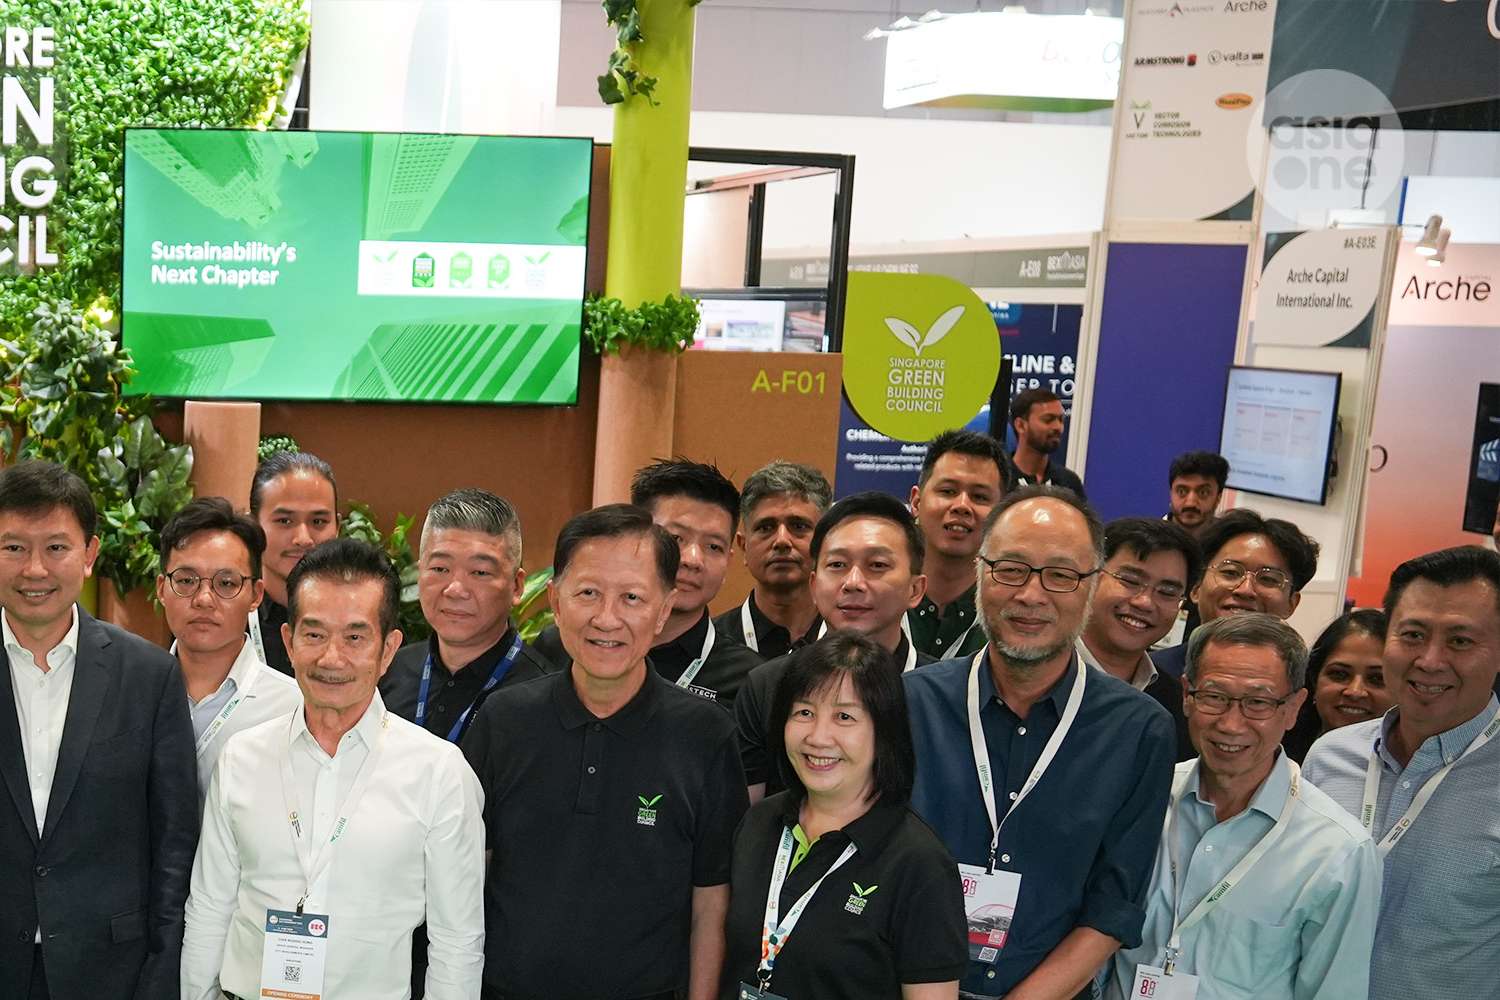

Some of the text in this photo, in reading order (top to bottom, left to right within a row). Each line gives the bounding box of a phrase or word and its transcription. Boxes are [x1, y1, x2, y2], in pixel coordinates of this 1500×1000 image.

[151, 241, 297, 266] Sustainability's
[151, 264, 280, 290] Next Chapter
[1287, 267, 1348, 285] Arche Capital
[1402, 275, 1491, 301] Arche
[1276, 292, 1353, 308] International Inc.
[889, 357, 946, 369] SINGAPORE
[751, 369, 826, 394] A-F01
[888, 368, 945, 386] GREEN
[887, 386, 944, 400] BUILDING
[886, 399, 942, 412] COUNCIL
